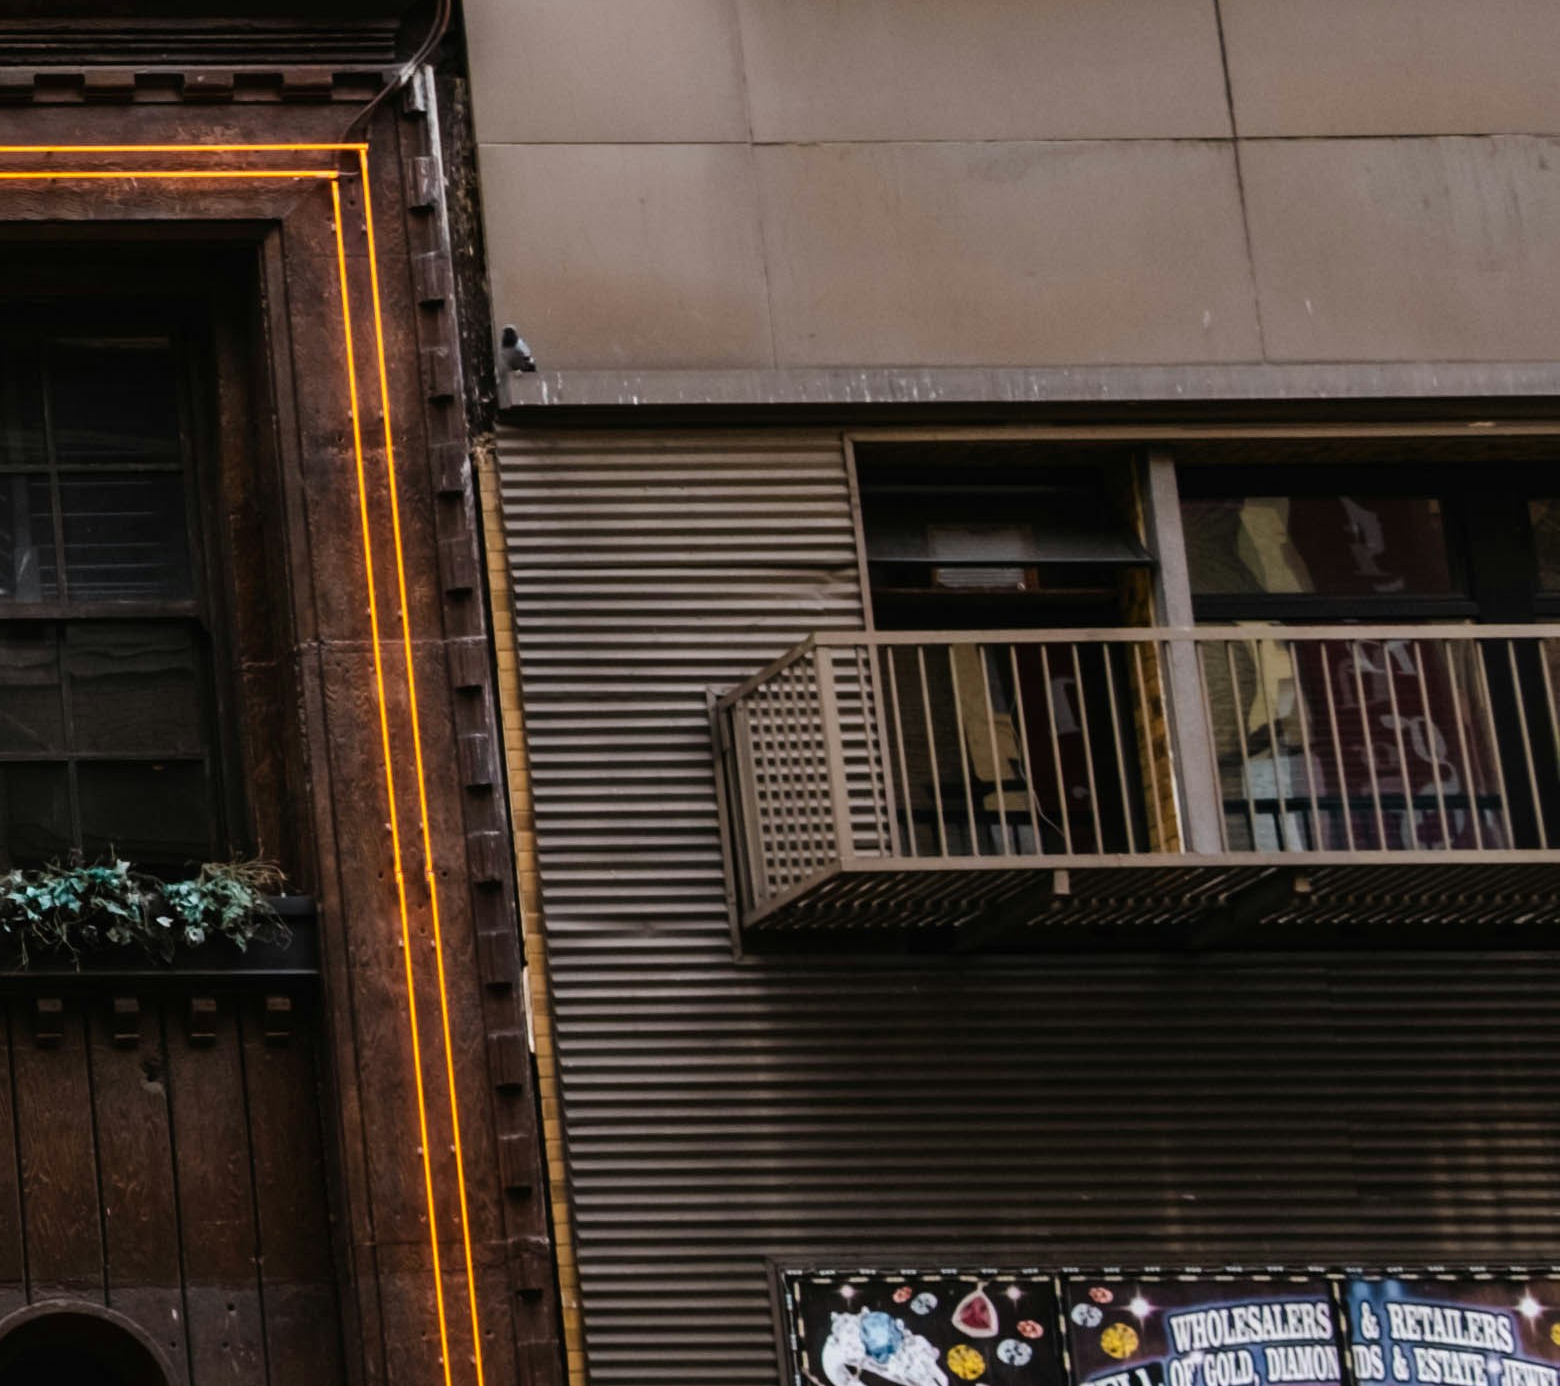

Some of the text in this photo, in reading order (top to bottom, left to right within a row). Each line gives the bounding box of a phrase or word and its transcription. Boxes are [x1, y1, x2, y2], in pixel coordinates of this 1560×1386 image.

[1170, 1301, 1515, 1354] WHOLESALERS & RETAILERS
[1392, 1344, 1410, 1382] &
